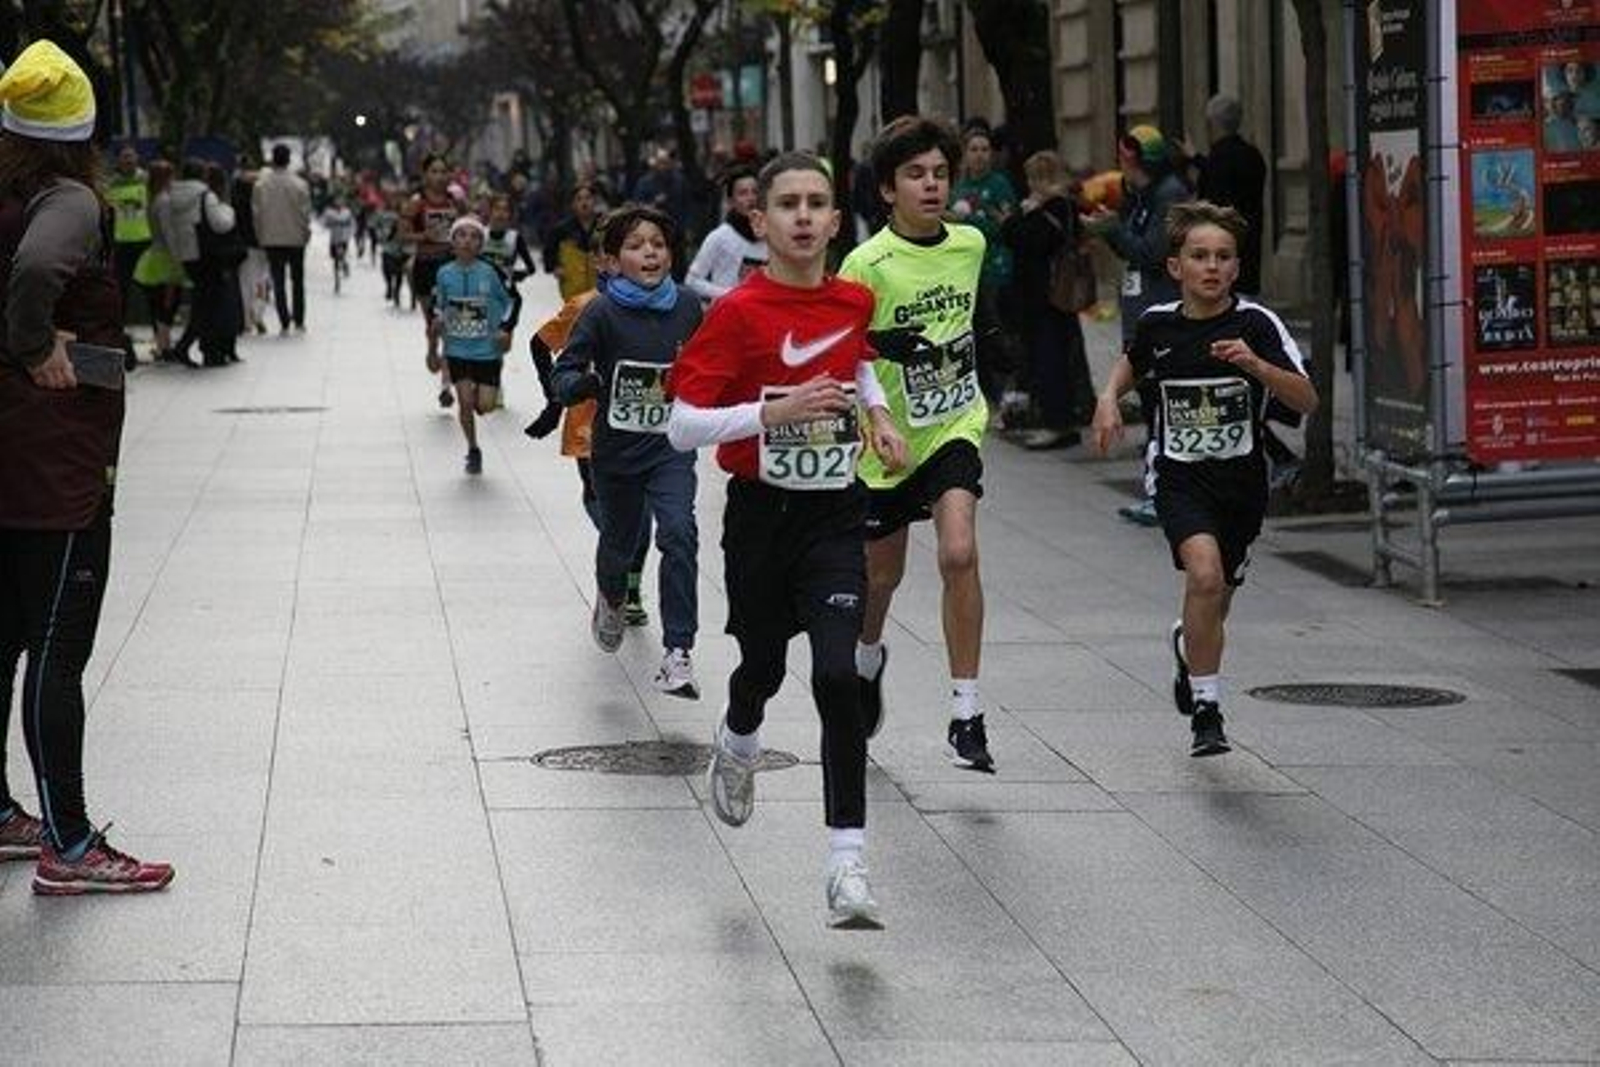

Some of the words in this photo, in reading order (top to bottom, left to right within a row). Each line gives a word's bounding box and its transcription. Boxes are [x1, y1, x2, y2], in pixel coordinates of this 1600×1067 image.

[894, 292, 972, 324] GIGANTES
[911, 374, 976, 419] 3225
[1169, 399, 1191, 408] SAN
[1169, 425, 1245, 454] 3239
